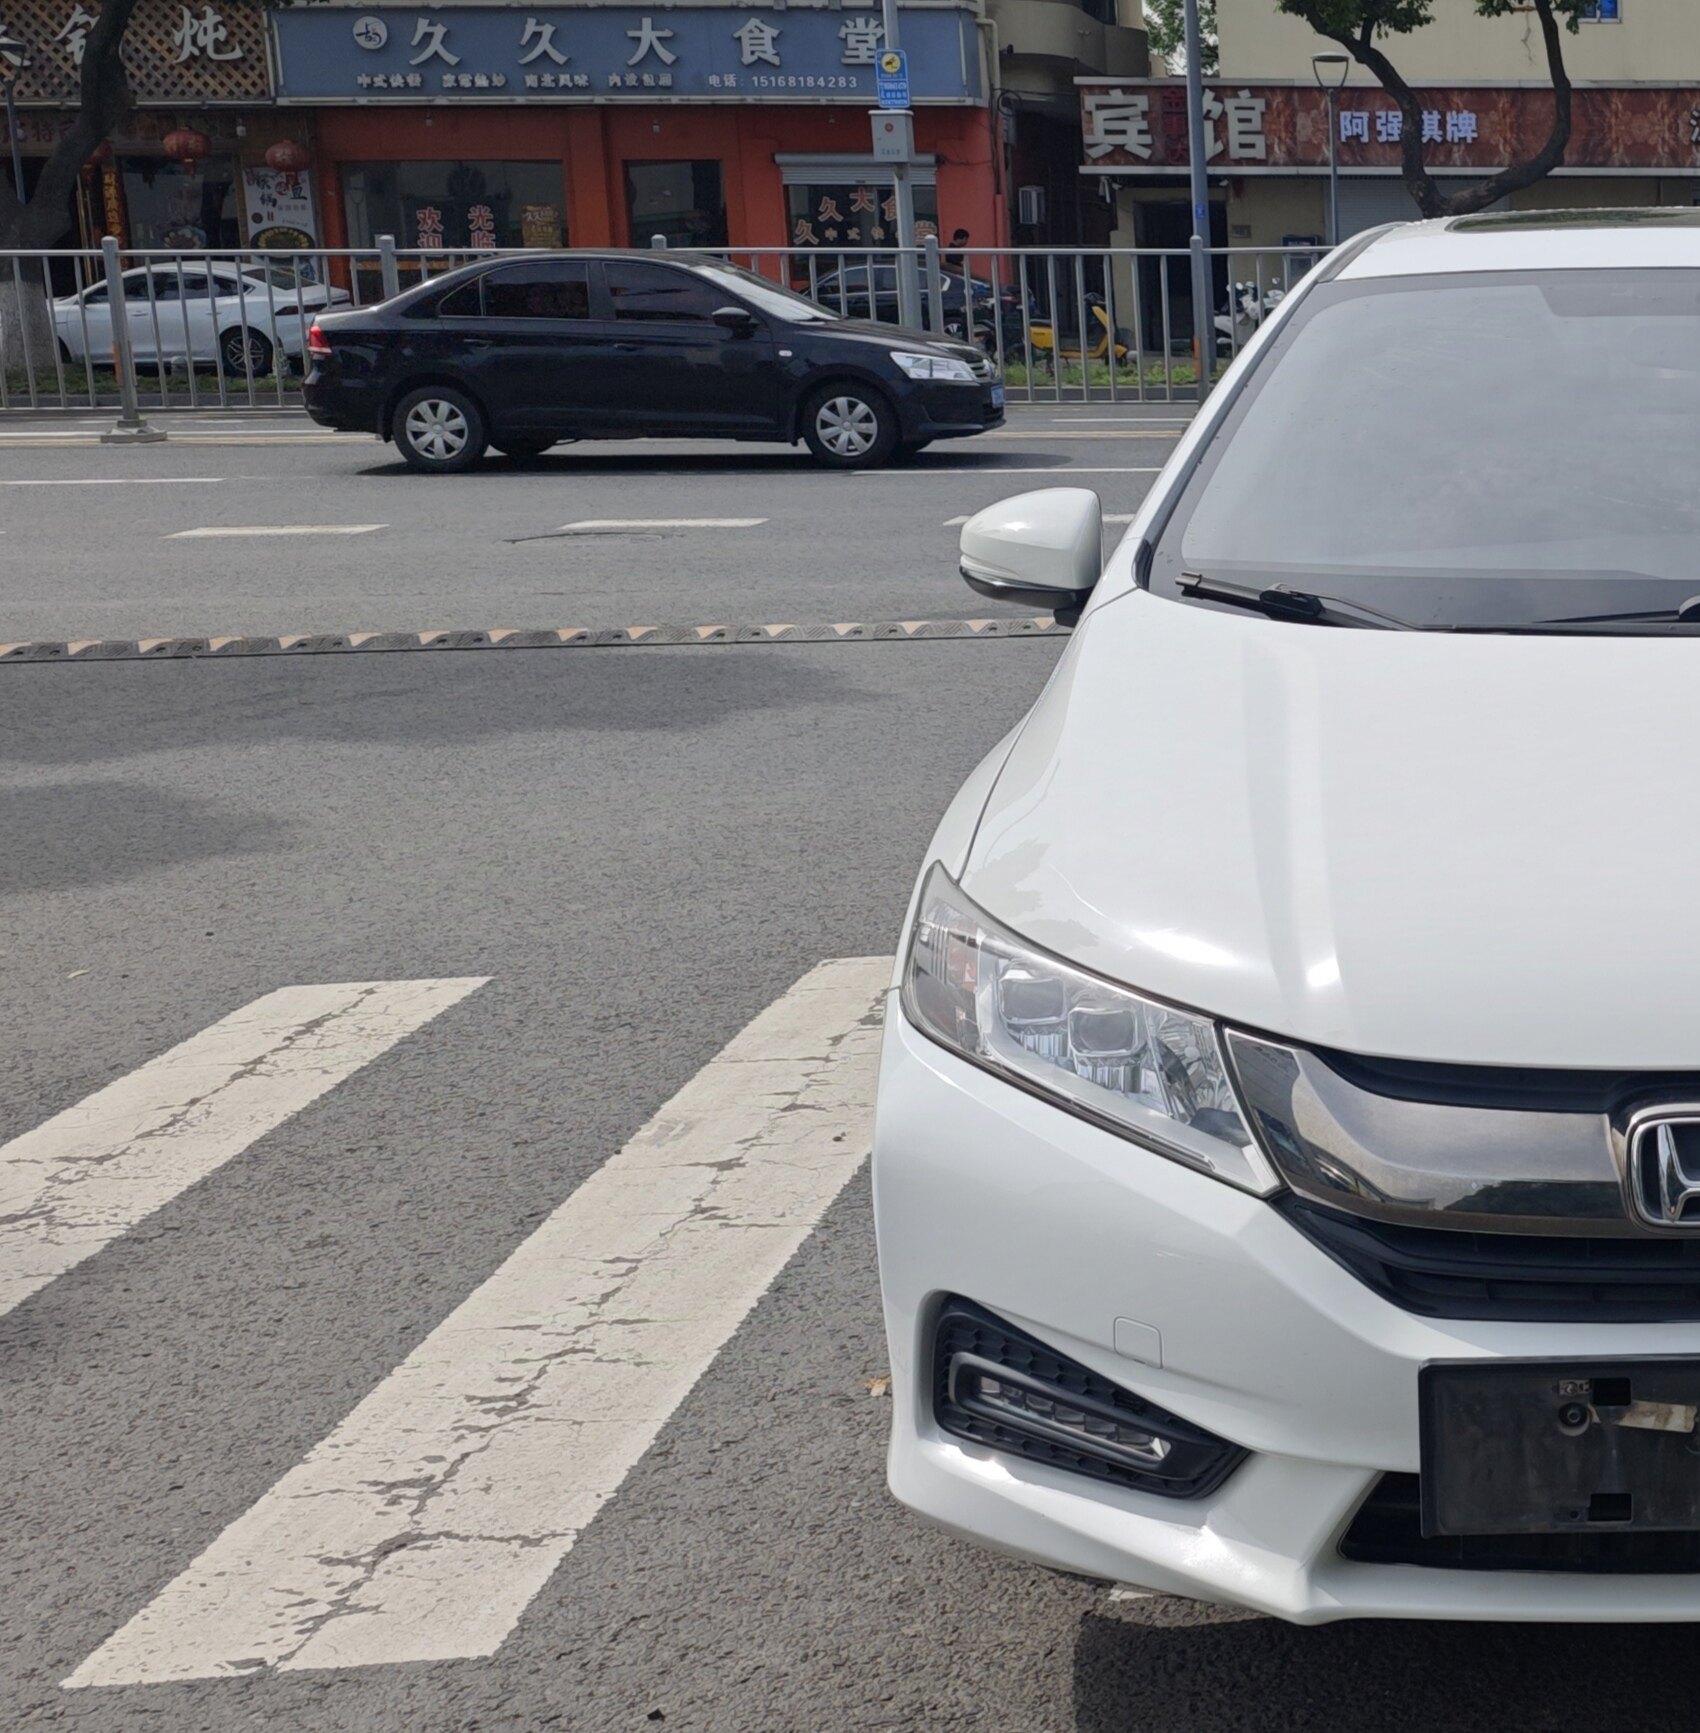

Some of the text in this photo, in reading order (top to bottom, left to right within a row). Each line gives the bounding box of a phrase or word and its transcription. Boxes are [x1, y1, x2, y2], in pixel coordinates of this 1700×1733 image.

[408, 17, 885, 67] 久久大食堂
[1083, 88, 1267, 161] 宾馆
